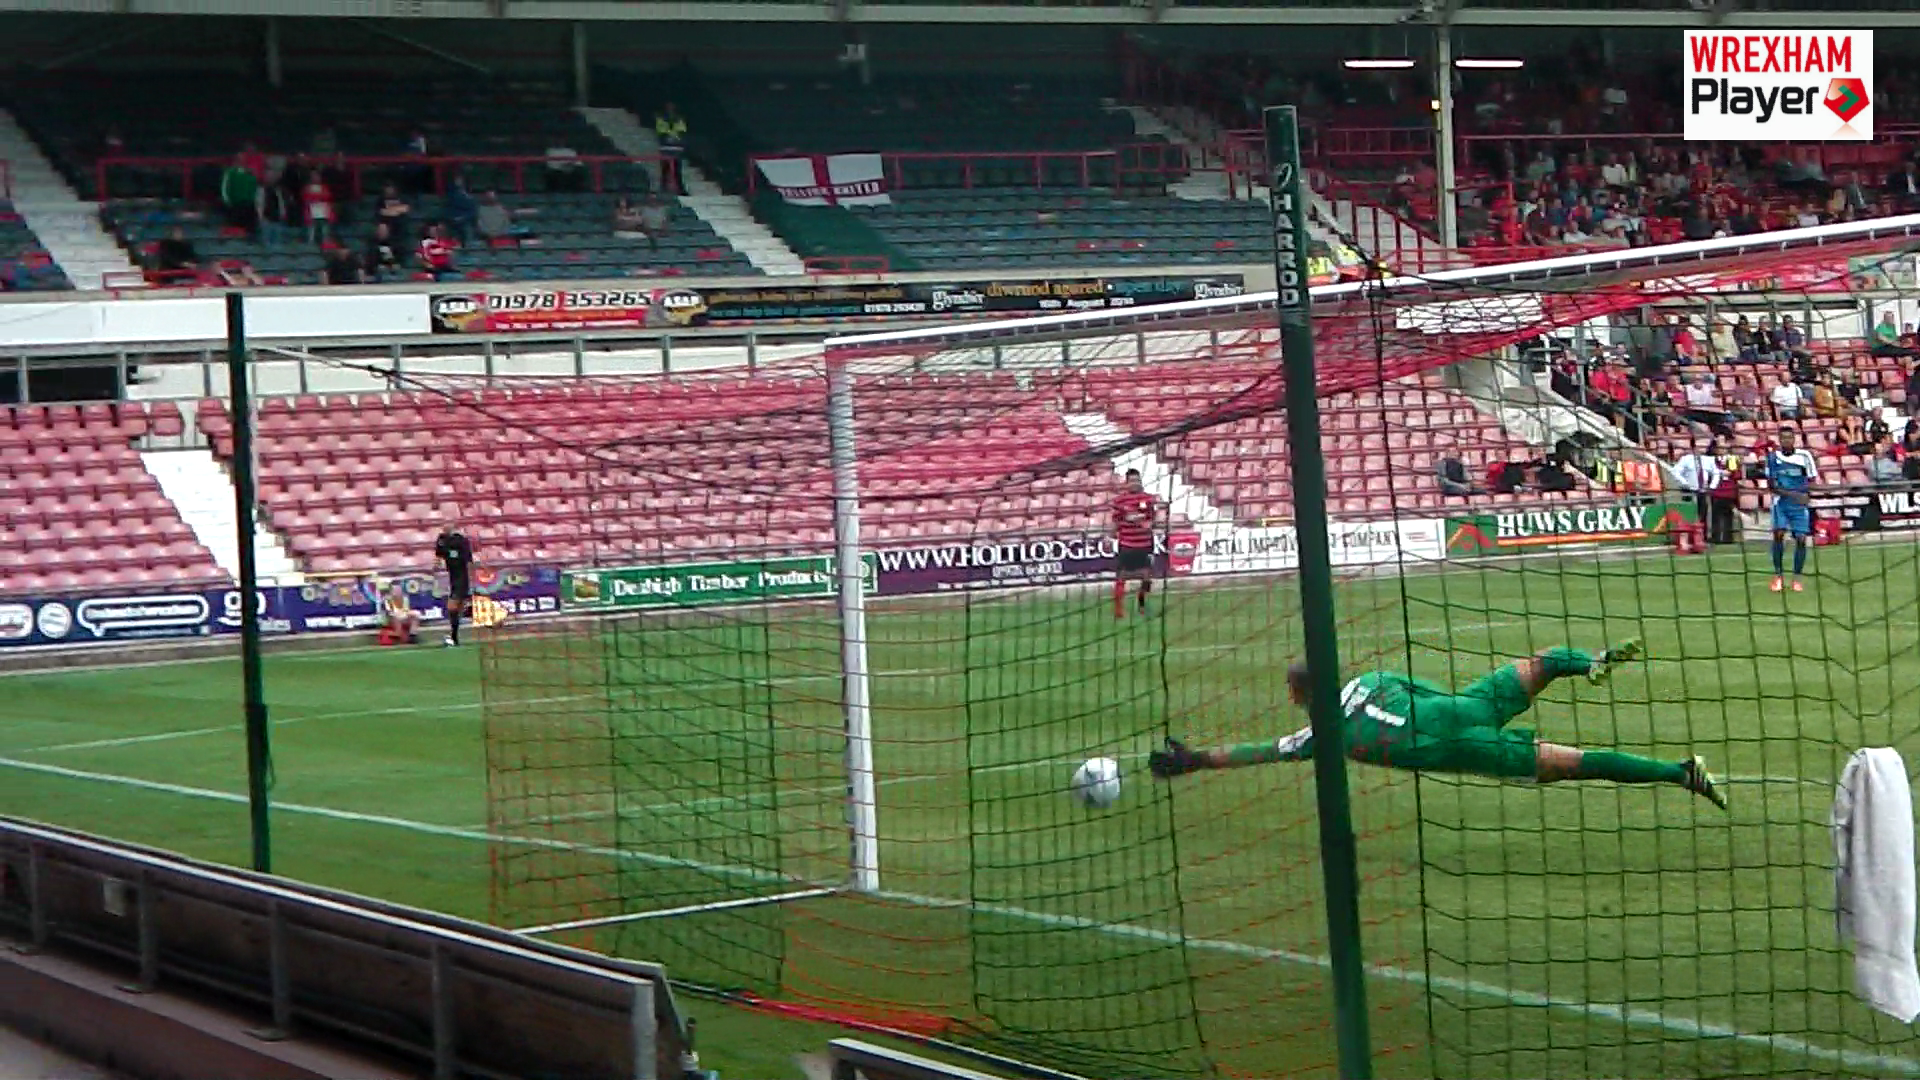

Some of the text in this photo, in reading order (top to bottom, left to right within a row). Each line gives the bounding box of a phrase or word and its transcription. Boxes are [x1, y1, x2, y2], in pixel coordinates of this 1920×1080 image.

[1273, 193, 1300, 306] HARROD
[490, 294, 555, 310] 01978
[565, 291, 651, 307] 353265
[1497, 506, 1647, 538] HUWS GRAY
[613, 568, 828, 597] Denbigh Timber Products
